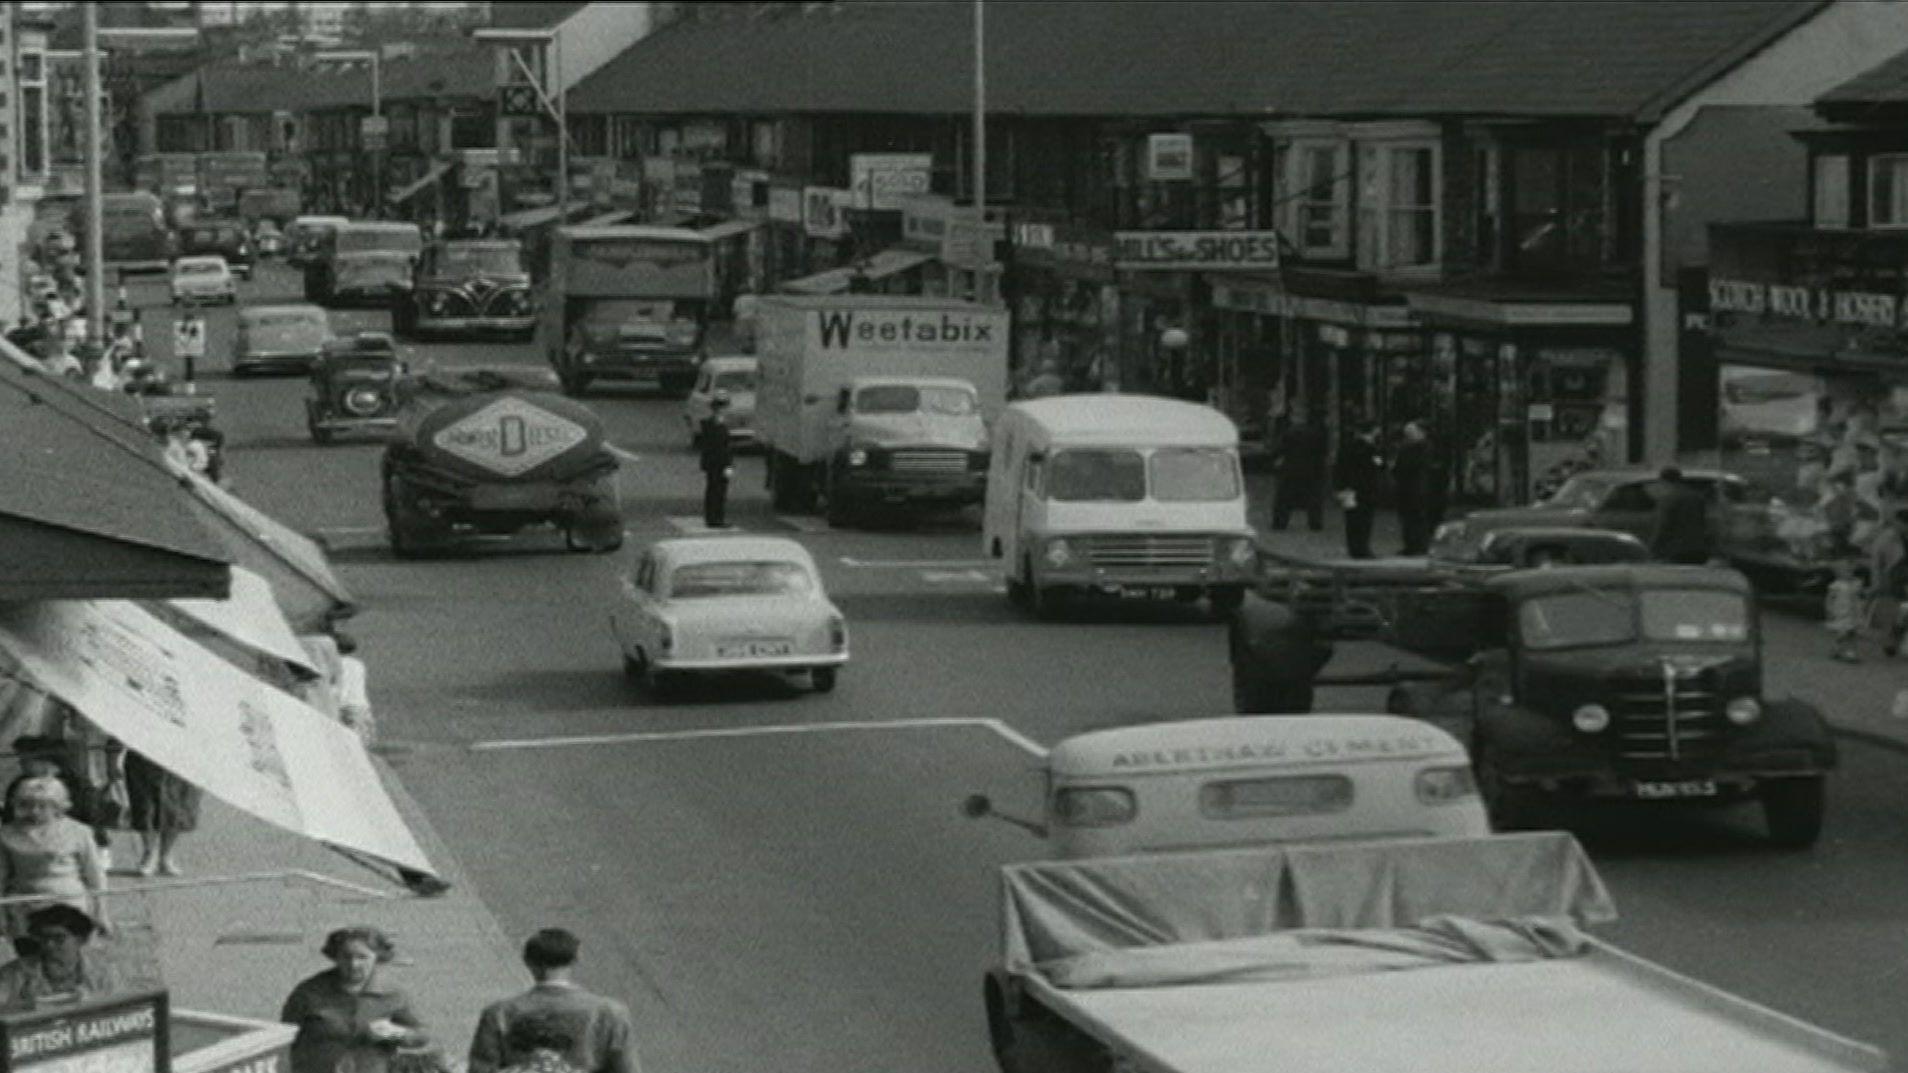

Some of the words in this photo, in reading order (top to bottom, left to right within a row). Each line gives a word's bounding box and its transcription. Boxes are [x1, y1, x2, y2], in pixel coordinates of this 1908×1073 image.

[1196, 237, 1275, 262] SHOES
[1709, 277, 1764, 312] SCOTCH
[1768, 284, 1811, 321] WOOL
[818, 308, 992, 350] Weetabix
[1302, 737, 1437, 757] CEMENT
[11, 1028, 72, 1060] BRITISH
[76, 1007, 155, 1046] RAILWAYS
